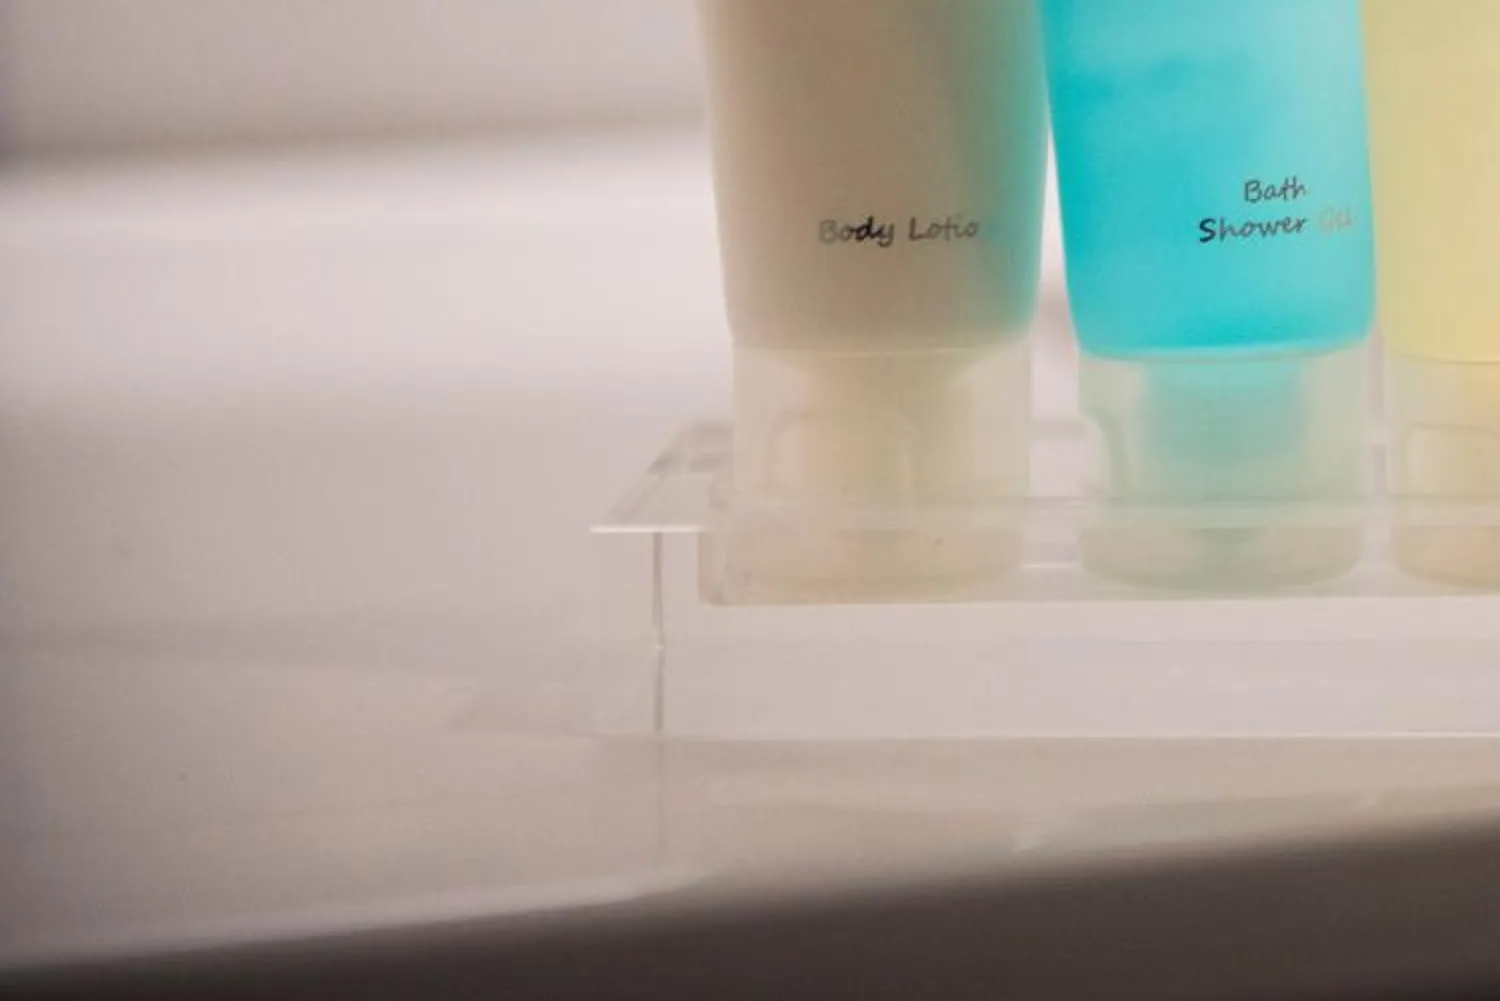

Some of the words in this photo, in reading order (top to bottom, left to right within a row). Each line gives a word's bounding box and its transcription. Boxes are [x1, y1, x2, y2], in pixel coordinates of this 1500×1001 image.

[1244, 175, 1307, 203] Bath
[819, 215, 895, 248] Body
[908, 214, 982, 241] Lotio
[1199, 215, 1307, 243] Shower
